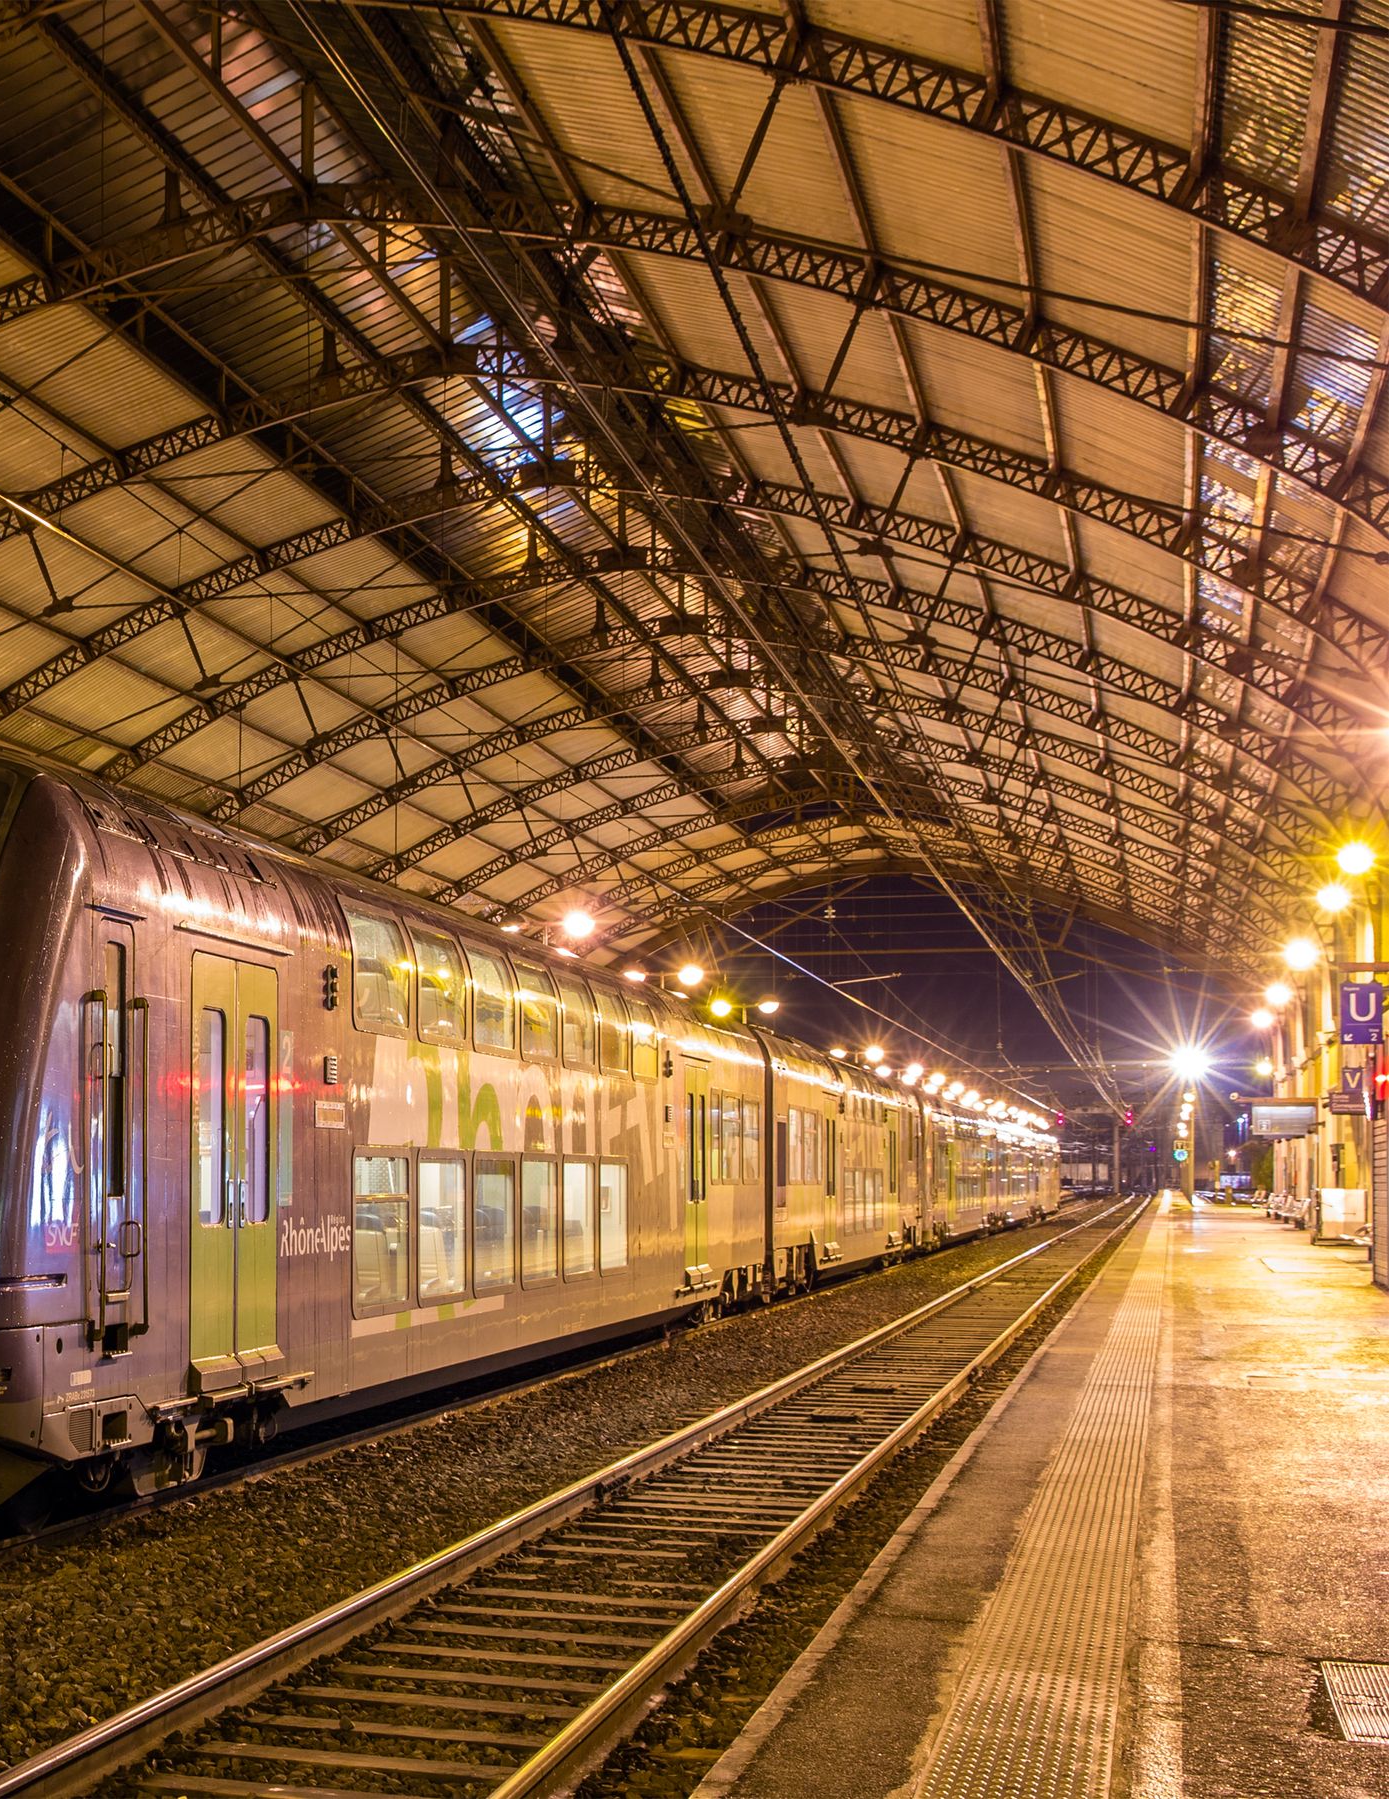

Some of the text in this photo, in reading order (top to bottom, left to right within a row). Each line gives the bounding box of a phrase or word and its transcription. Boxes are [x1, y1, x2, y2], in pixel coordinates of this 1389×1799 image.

[1349, 992, 1377, 1022] U
[1370, 1033, 1378, 1042] 2
[282, 1035, 292, 1074] 2
[1345, 1072, 1361, 1089] V
[46, 1222, 79, 1247] SNCF
